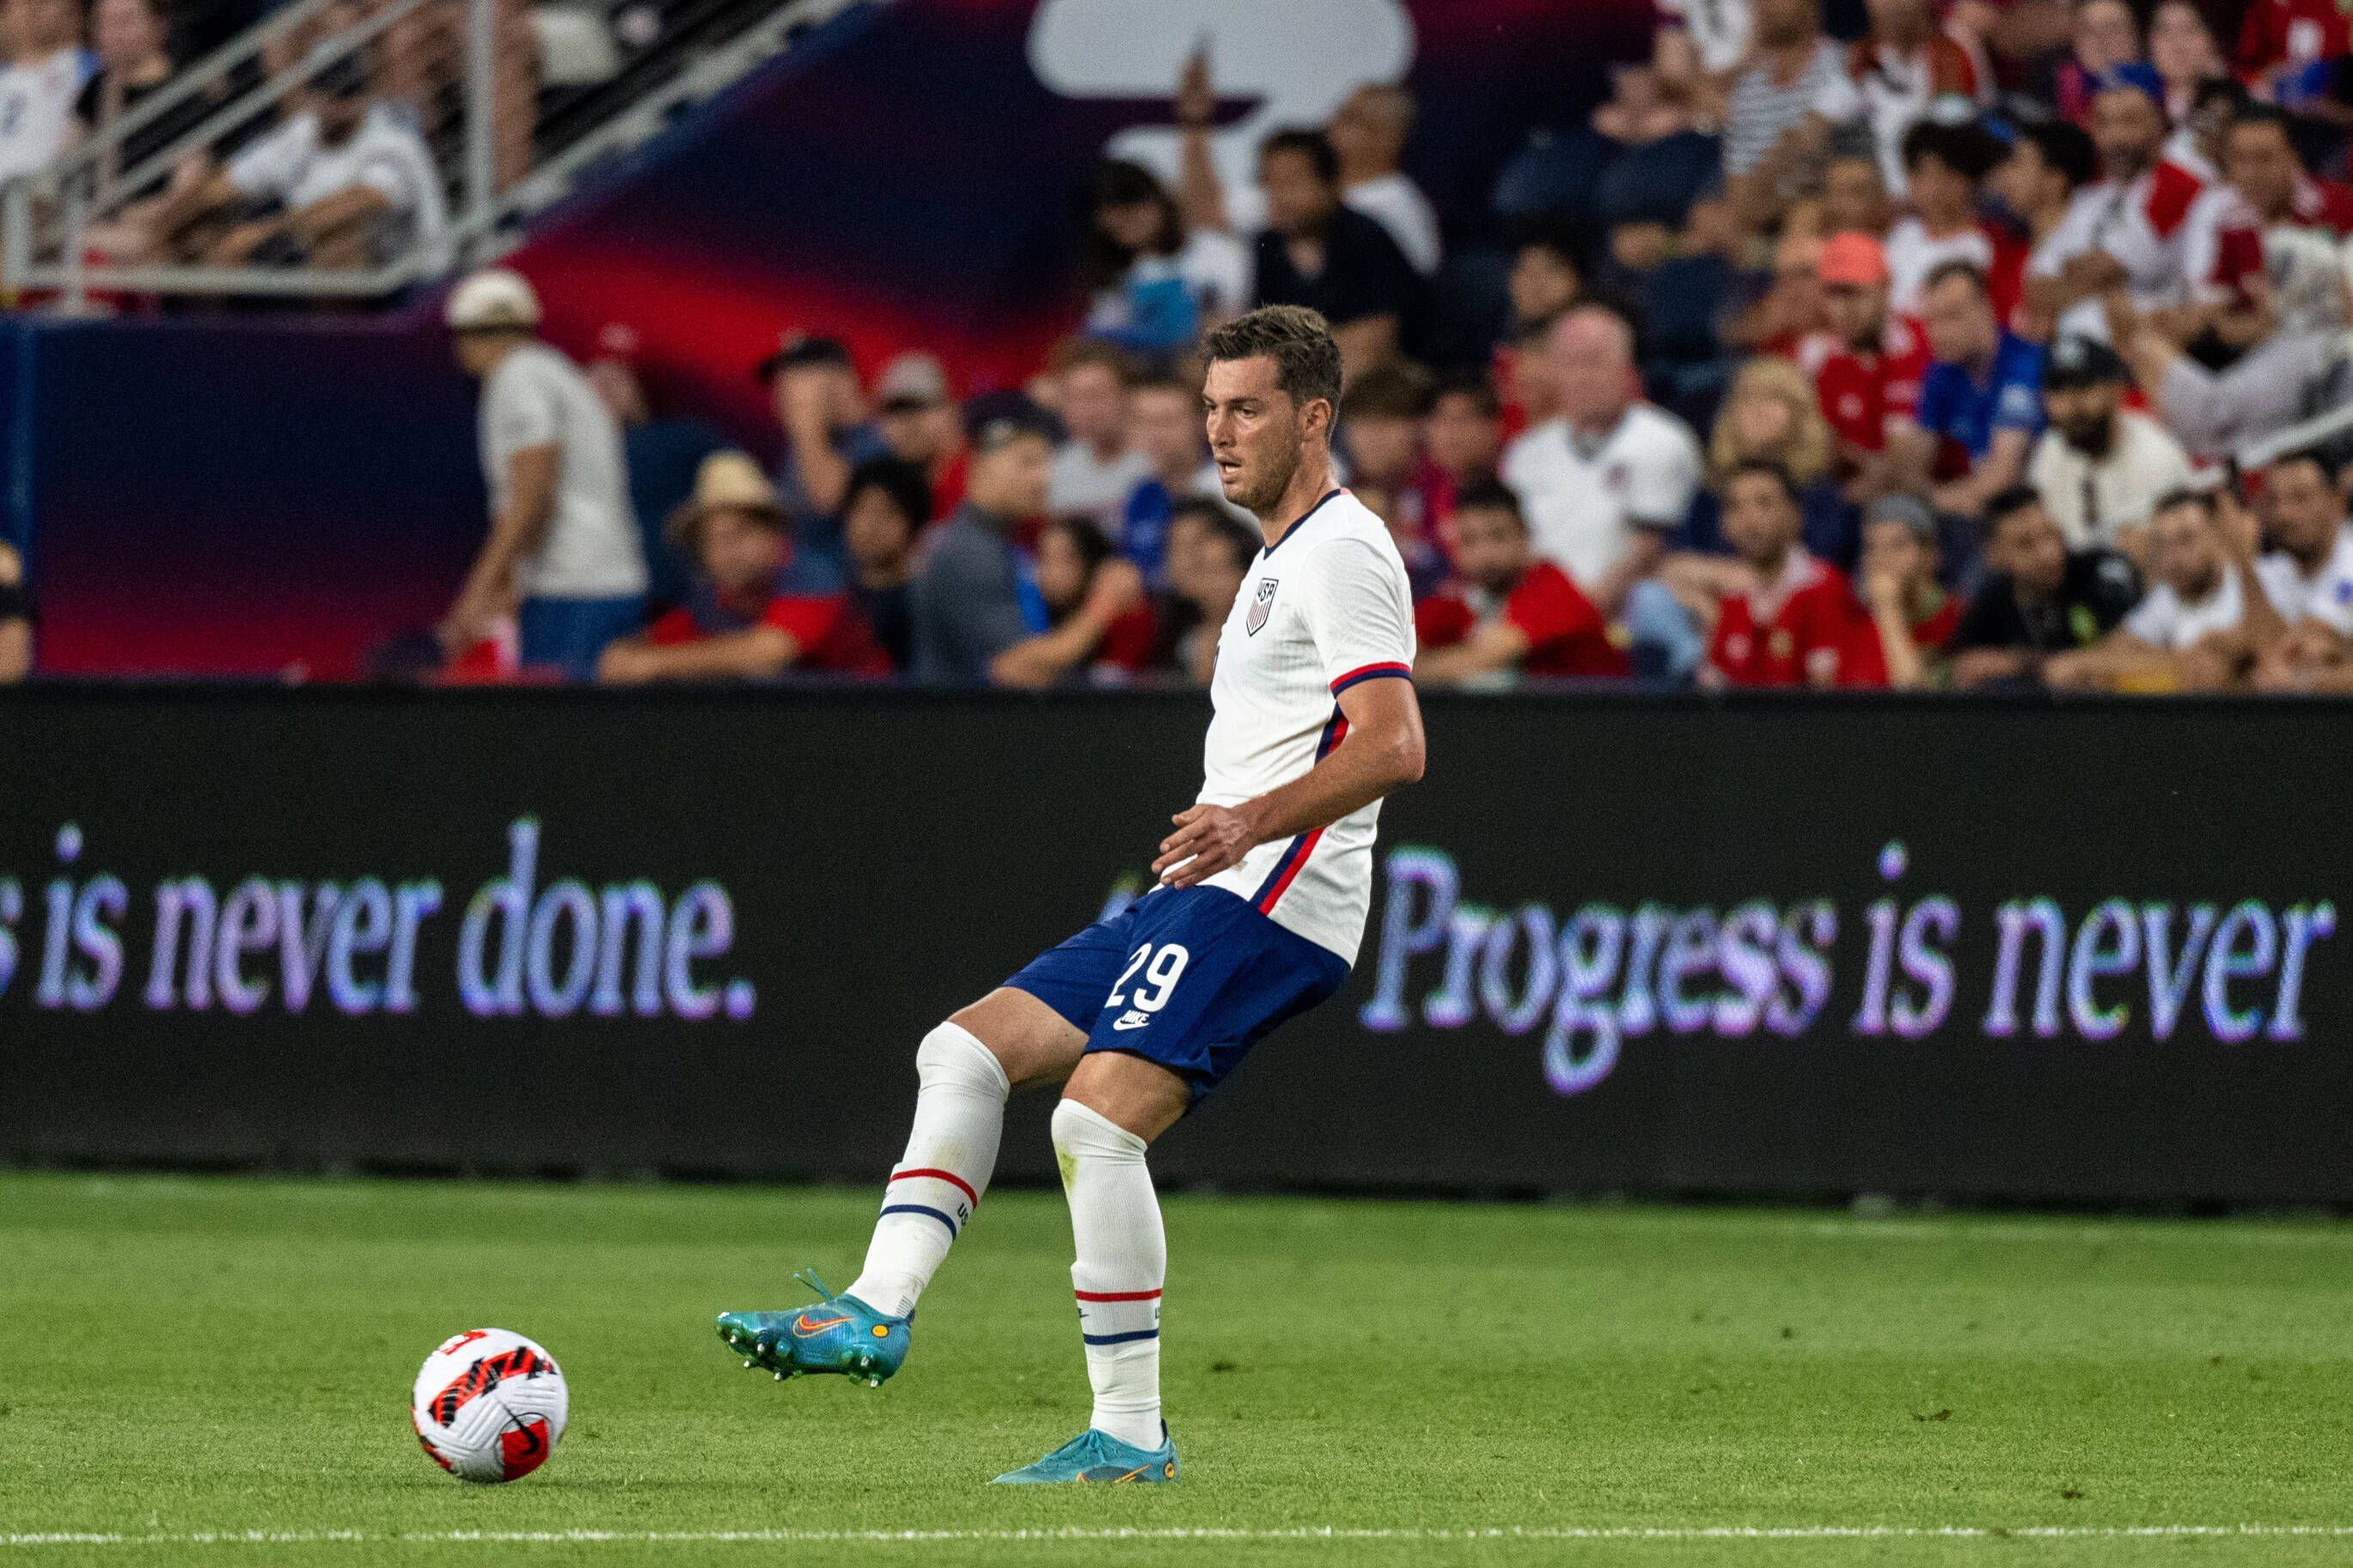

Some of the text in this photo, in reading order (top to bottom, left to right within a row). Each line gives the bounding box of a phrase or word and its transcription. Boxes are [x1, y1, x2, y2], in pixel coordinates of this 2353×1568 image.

[1257, 583, 1275, 602] USA
[36, 822, 129, 1010] is
[144, 875, 443, 1015] never
[456, 813, 757, 1020] done.
[1104, 943, 1189, 1012] 29
[1363, 841, 2337, 1095] Progress is never
[1121, 1010, 1150, 1025] NIKE
